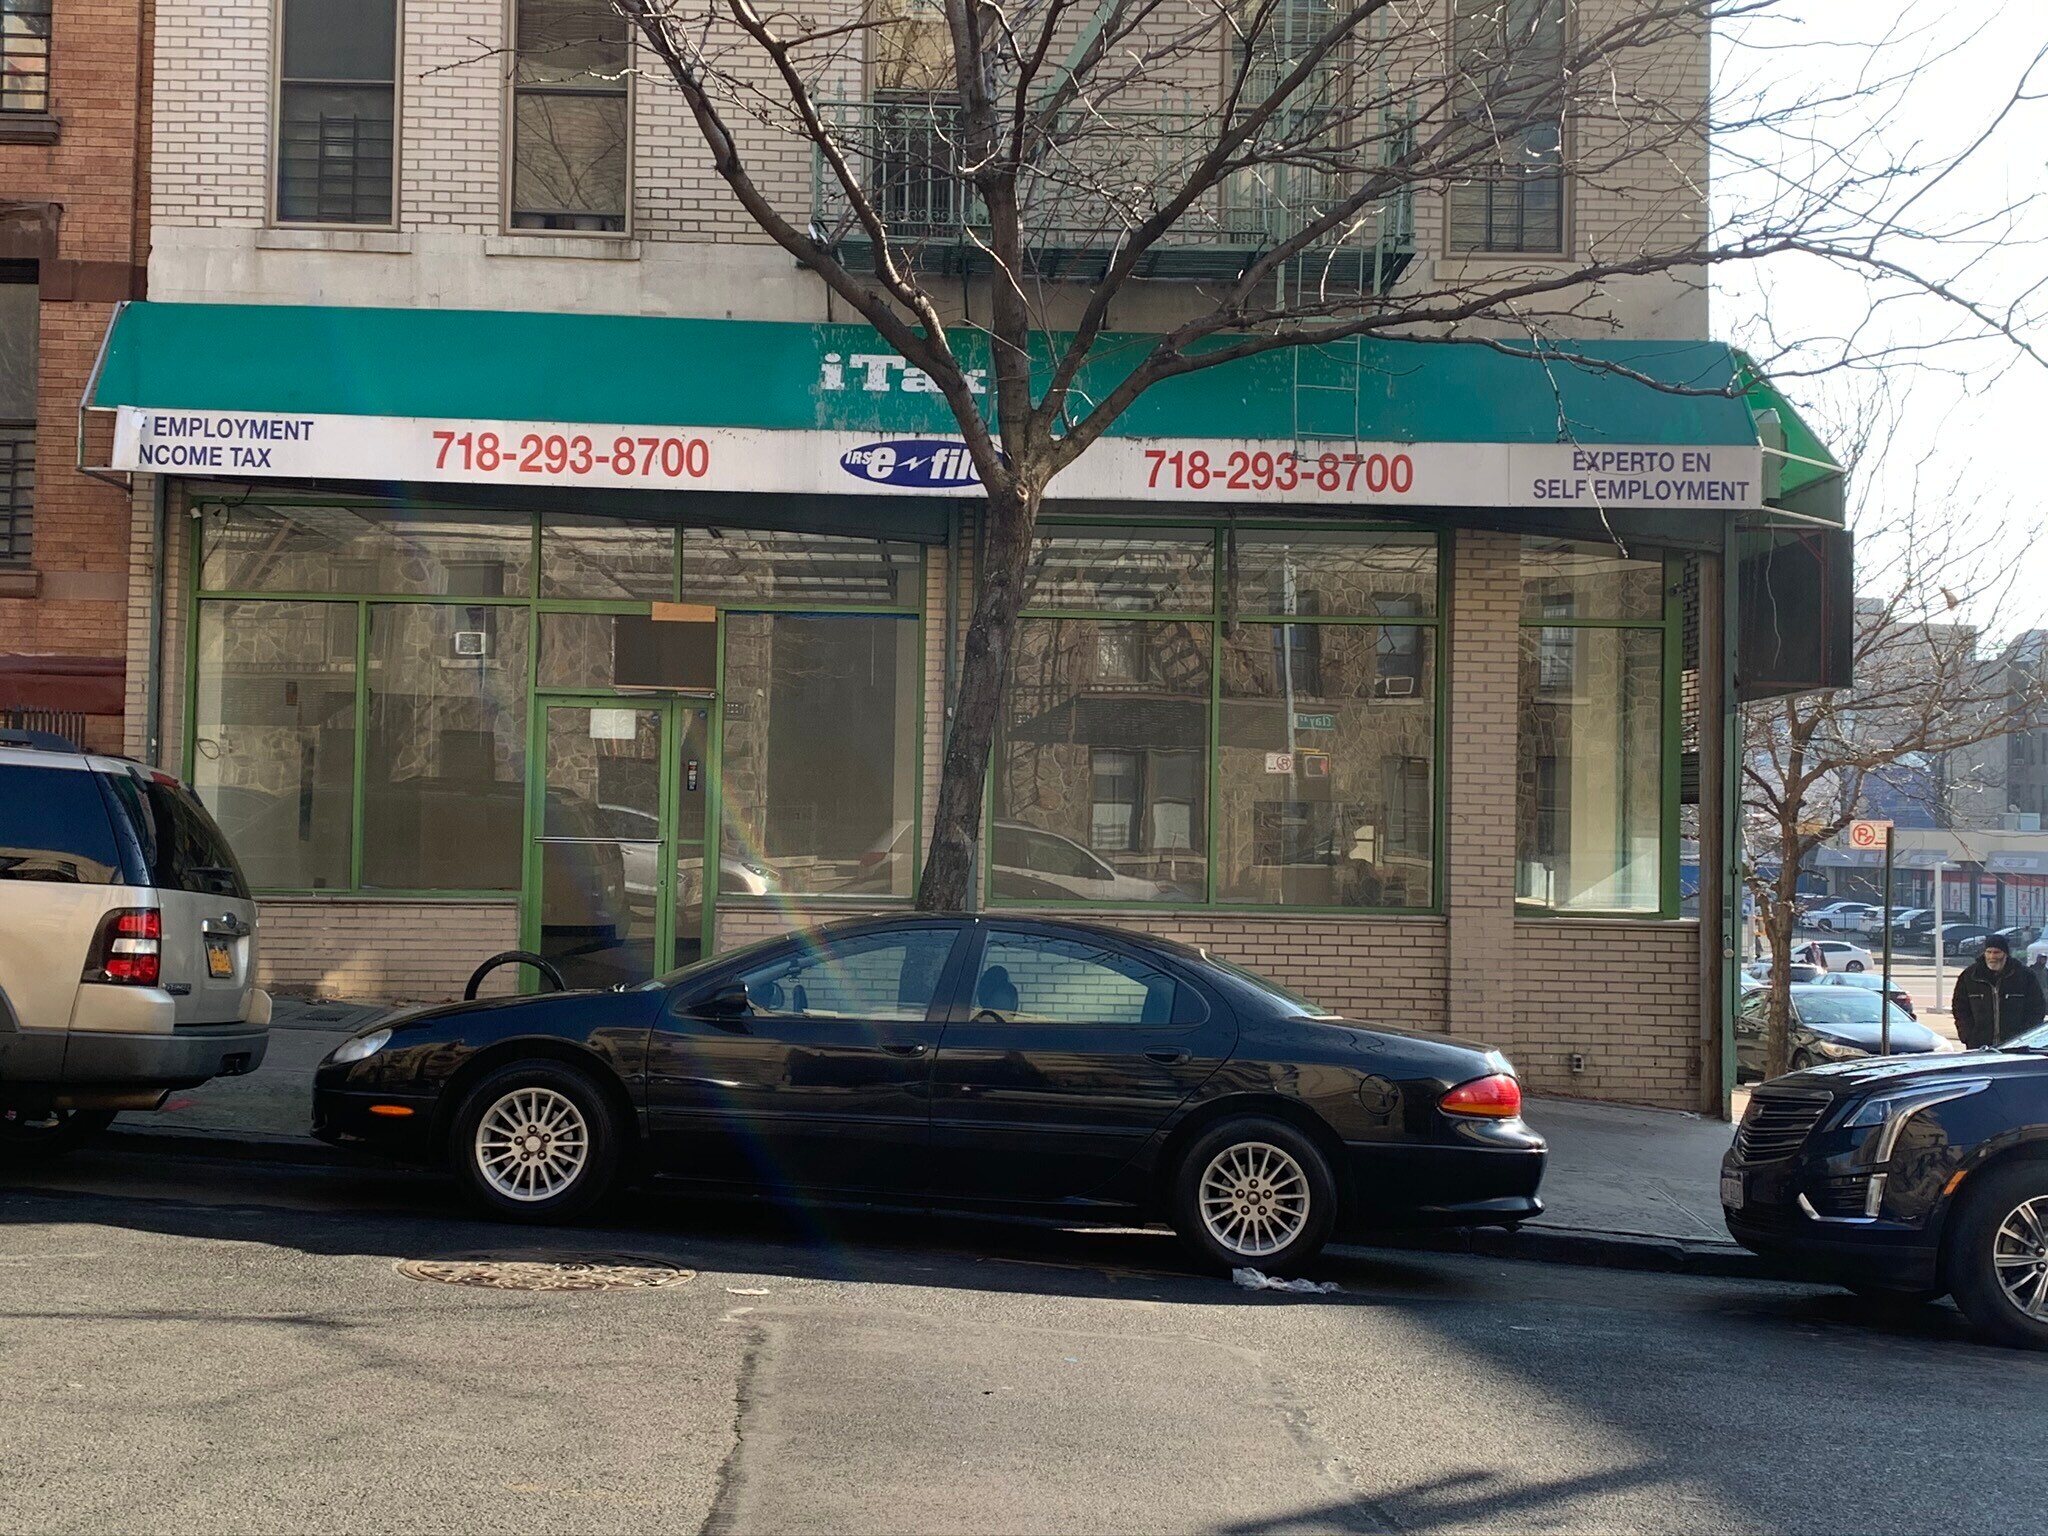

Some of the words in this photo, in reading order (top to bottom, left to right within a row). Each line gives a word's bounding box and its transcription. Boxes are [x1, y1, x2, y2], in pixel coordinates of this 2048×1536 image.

[153, 416, 314, 441] EMPLOYMENT
[139, 443, 223, 467] NCOME
[229, 447, 272, 468] TAX
[432, 431, 709, 478] 718-293-8700
[929, 448, 981, 481] fil
[1573, 450, 1675, 473] EXPERTO
[1682, 452, 1711, 473] EN
[1144, 449, 1414, 493] 718-293-8700
[1533, 478, 1587, 499] SELF
[1594, 480, 1750, 502] EMPLOYMENT
